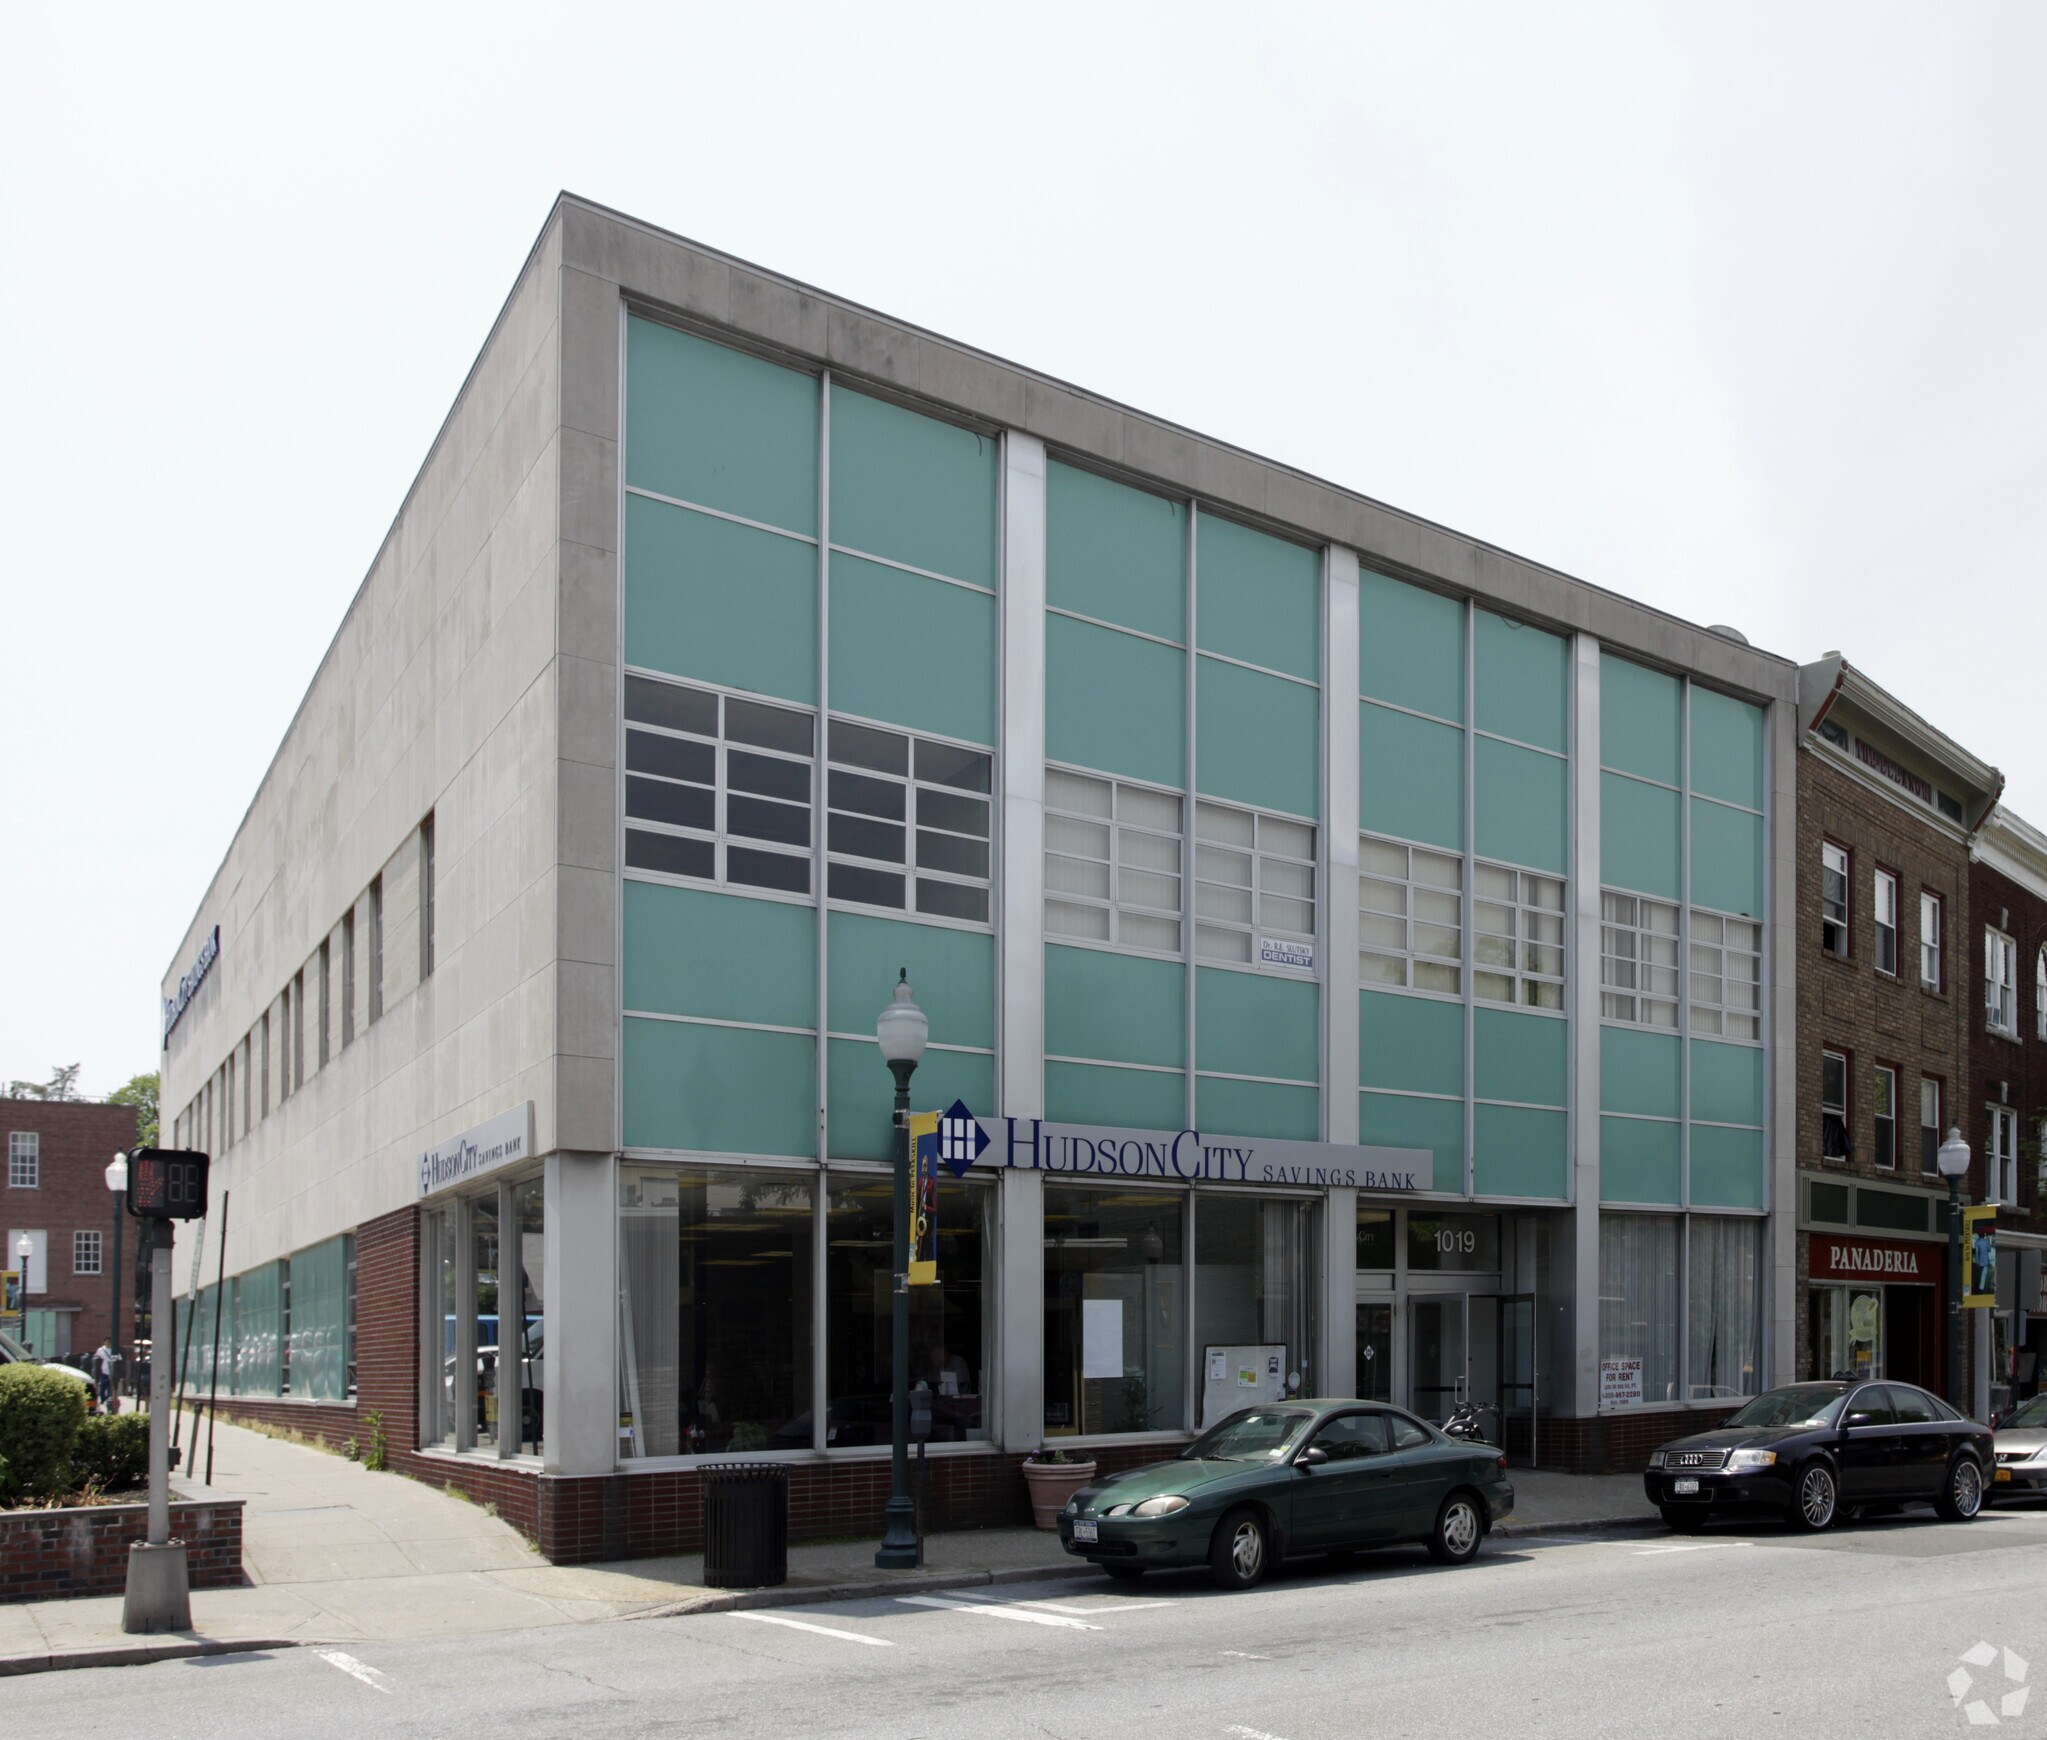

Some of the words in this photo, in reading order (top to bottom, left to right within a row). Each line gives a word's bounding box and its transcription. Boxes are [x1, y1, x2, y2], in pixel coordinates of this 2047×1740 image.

[1263, 950, 1310, 965] DENTIST
[478, 1144, 503, 1166] SAVINGS
[505, 1136, 521, 1155] BANK
[1263, 1164, 1355, 1186] SAVINGS
[1365, 1170, 1415, 1190] BANK
[1433, 1230, 1476, 1253] 1019
[1830, 1246, 1918, 1273] PANADERIA
[1602, 1362, 1619, 1371] OFFICE
[1621, 1361, 1641, 1370] SPACE
[1606, 1373, 1616, 1381] FOR
[1618, 1372, 1634, 1381] RENT
